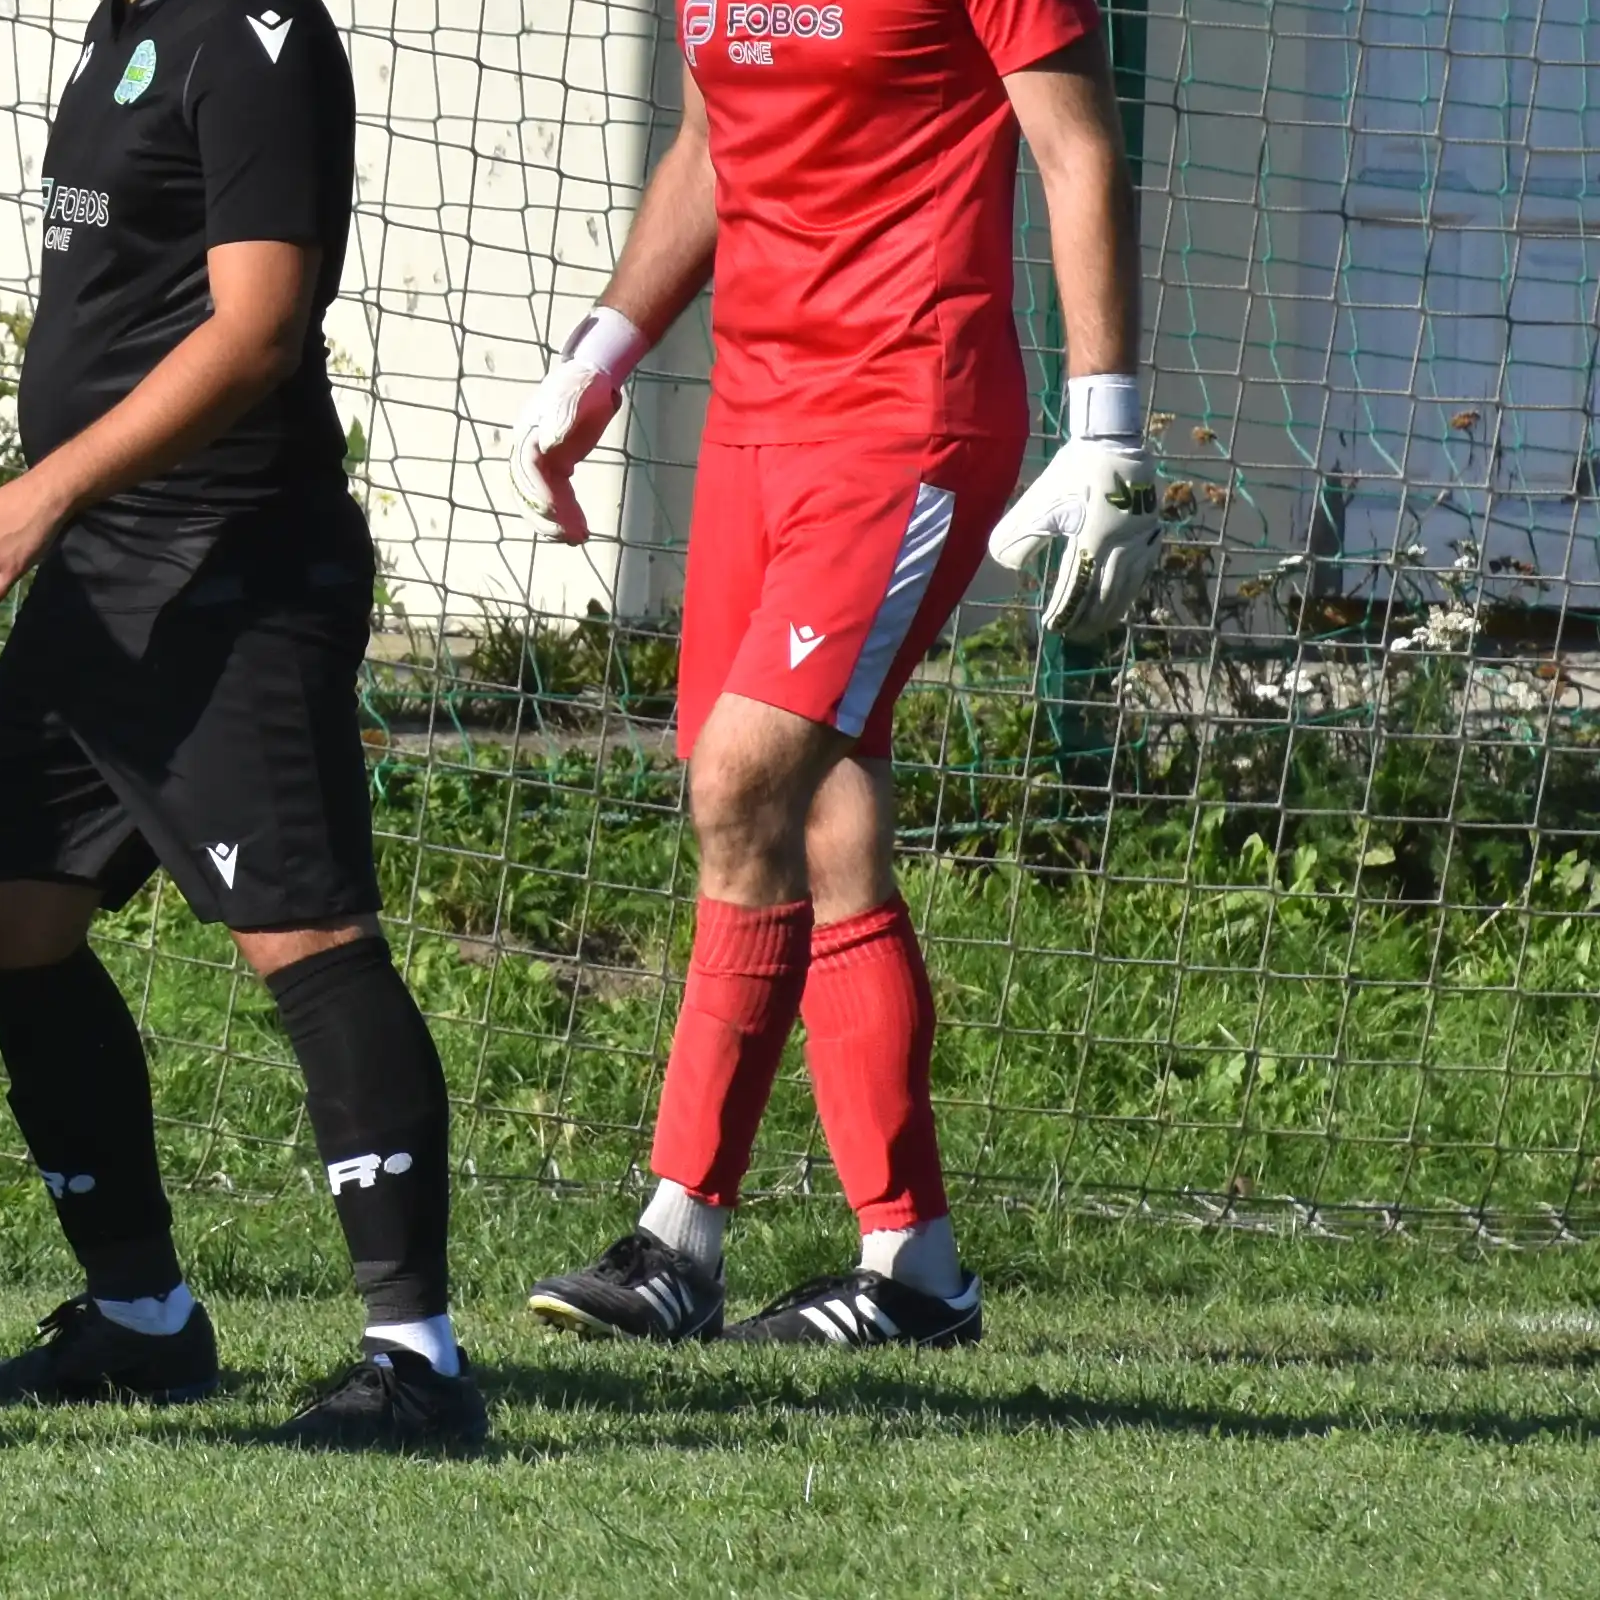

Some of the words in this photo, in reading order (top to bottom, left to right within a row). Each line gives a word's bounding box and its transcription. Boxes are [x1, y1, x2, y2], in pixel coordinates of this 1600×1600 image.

[727, 3, 843, 40] FOBOS
[728, 41, 774, 65] ONE
[50, 185, 109, 228] FOBOS
[44, 225, 73, 252] ONE
